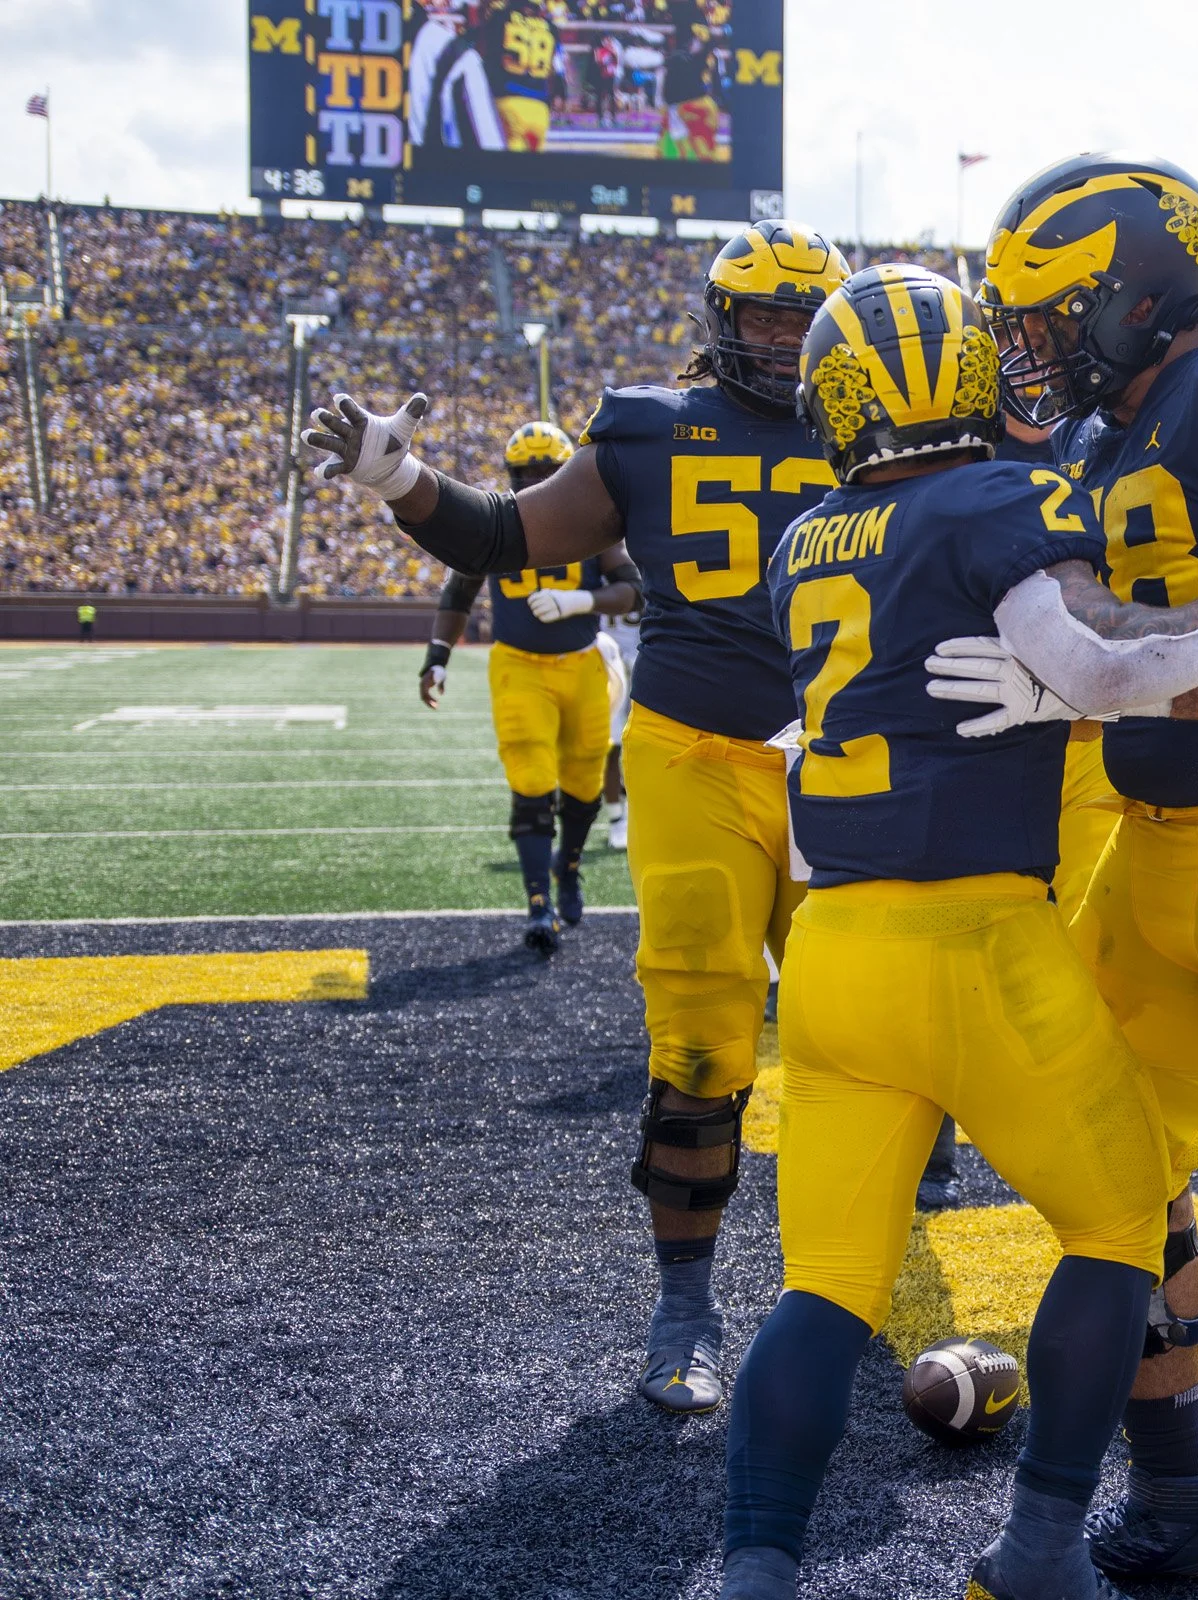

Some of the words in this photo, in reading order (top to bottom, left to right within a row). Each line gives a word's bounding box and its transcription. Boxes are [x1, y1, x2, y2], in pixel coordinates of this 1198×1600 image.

[251, 16, 301, 54] M
[318, 0, 402, 51] TD
[503, 20, 555, 79] 58
[318, 52, 402, 110] TD
[736, 49, 782, 86] M
[318, 110, 403, 168] TD
[264, 168, 325, 196] 4:36
[346, 178, 373, 198] M
[795, 282, 812, 294] M
[869, 404, 880, 421] 2
[1029, 469, 1087, 533] 2
[788, 502, 897, 576] CORUM
[789, 573, 892, 798] 2
